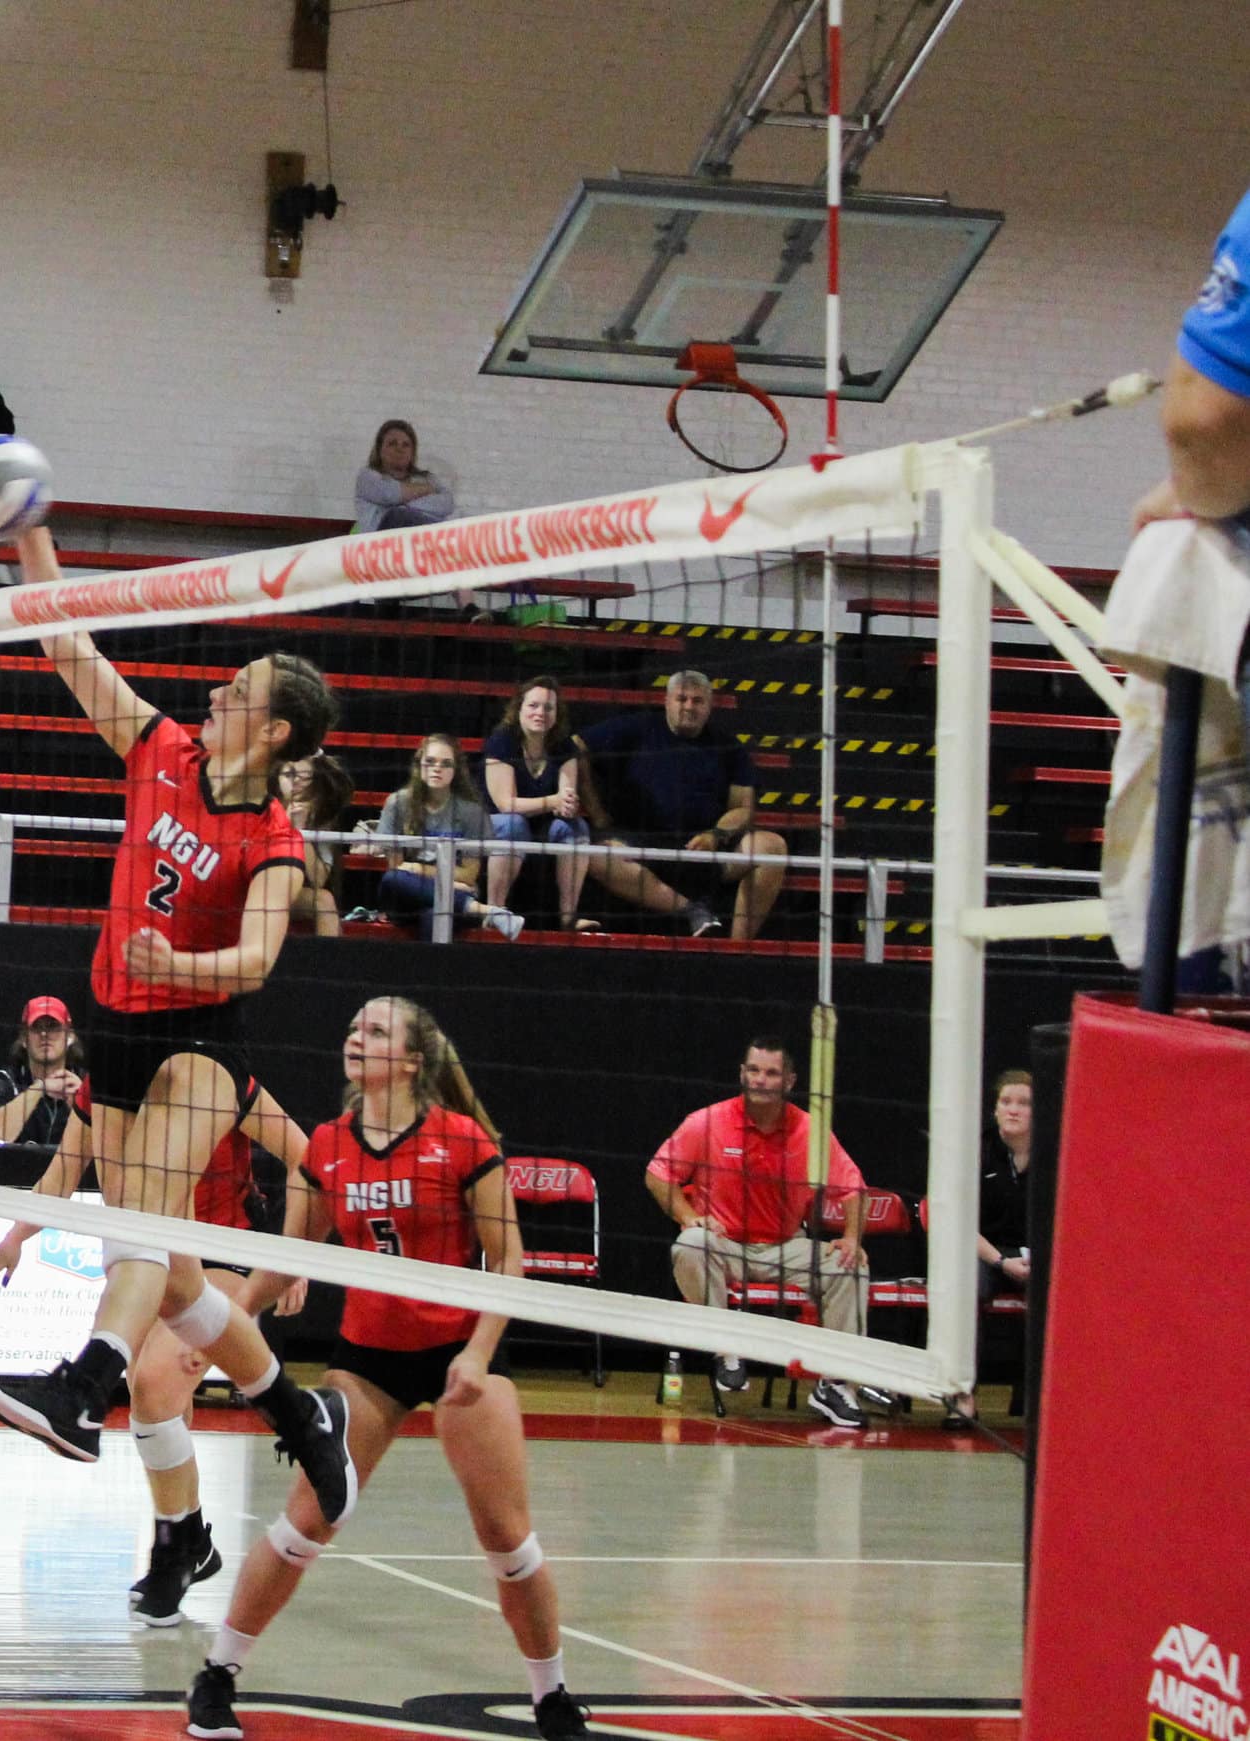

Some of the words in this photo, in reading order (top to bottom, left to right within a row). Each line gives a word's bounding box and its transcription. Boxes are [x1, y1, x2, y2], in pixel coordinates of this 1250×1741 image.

[342, 536, 410, 584] NORTH
[411, 516, 530, 577] GREENVILLE
[526, 497, 658, 559] UNIVERSITY
[147, 812, 220, 881] NGU
[145, 859, 182, 917] 2
[345, 1179, 412, 1212] NGU
[507, 1165, 579, 1191] NGU
[1147, 1669, 1250, 1741] AMERIC
